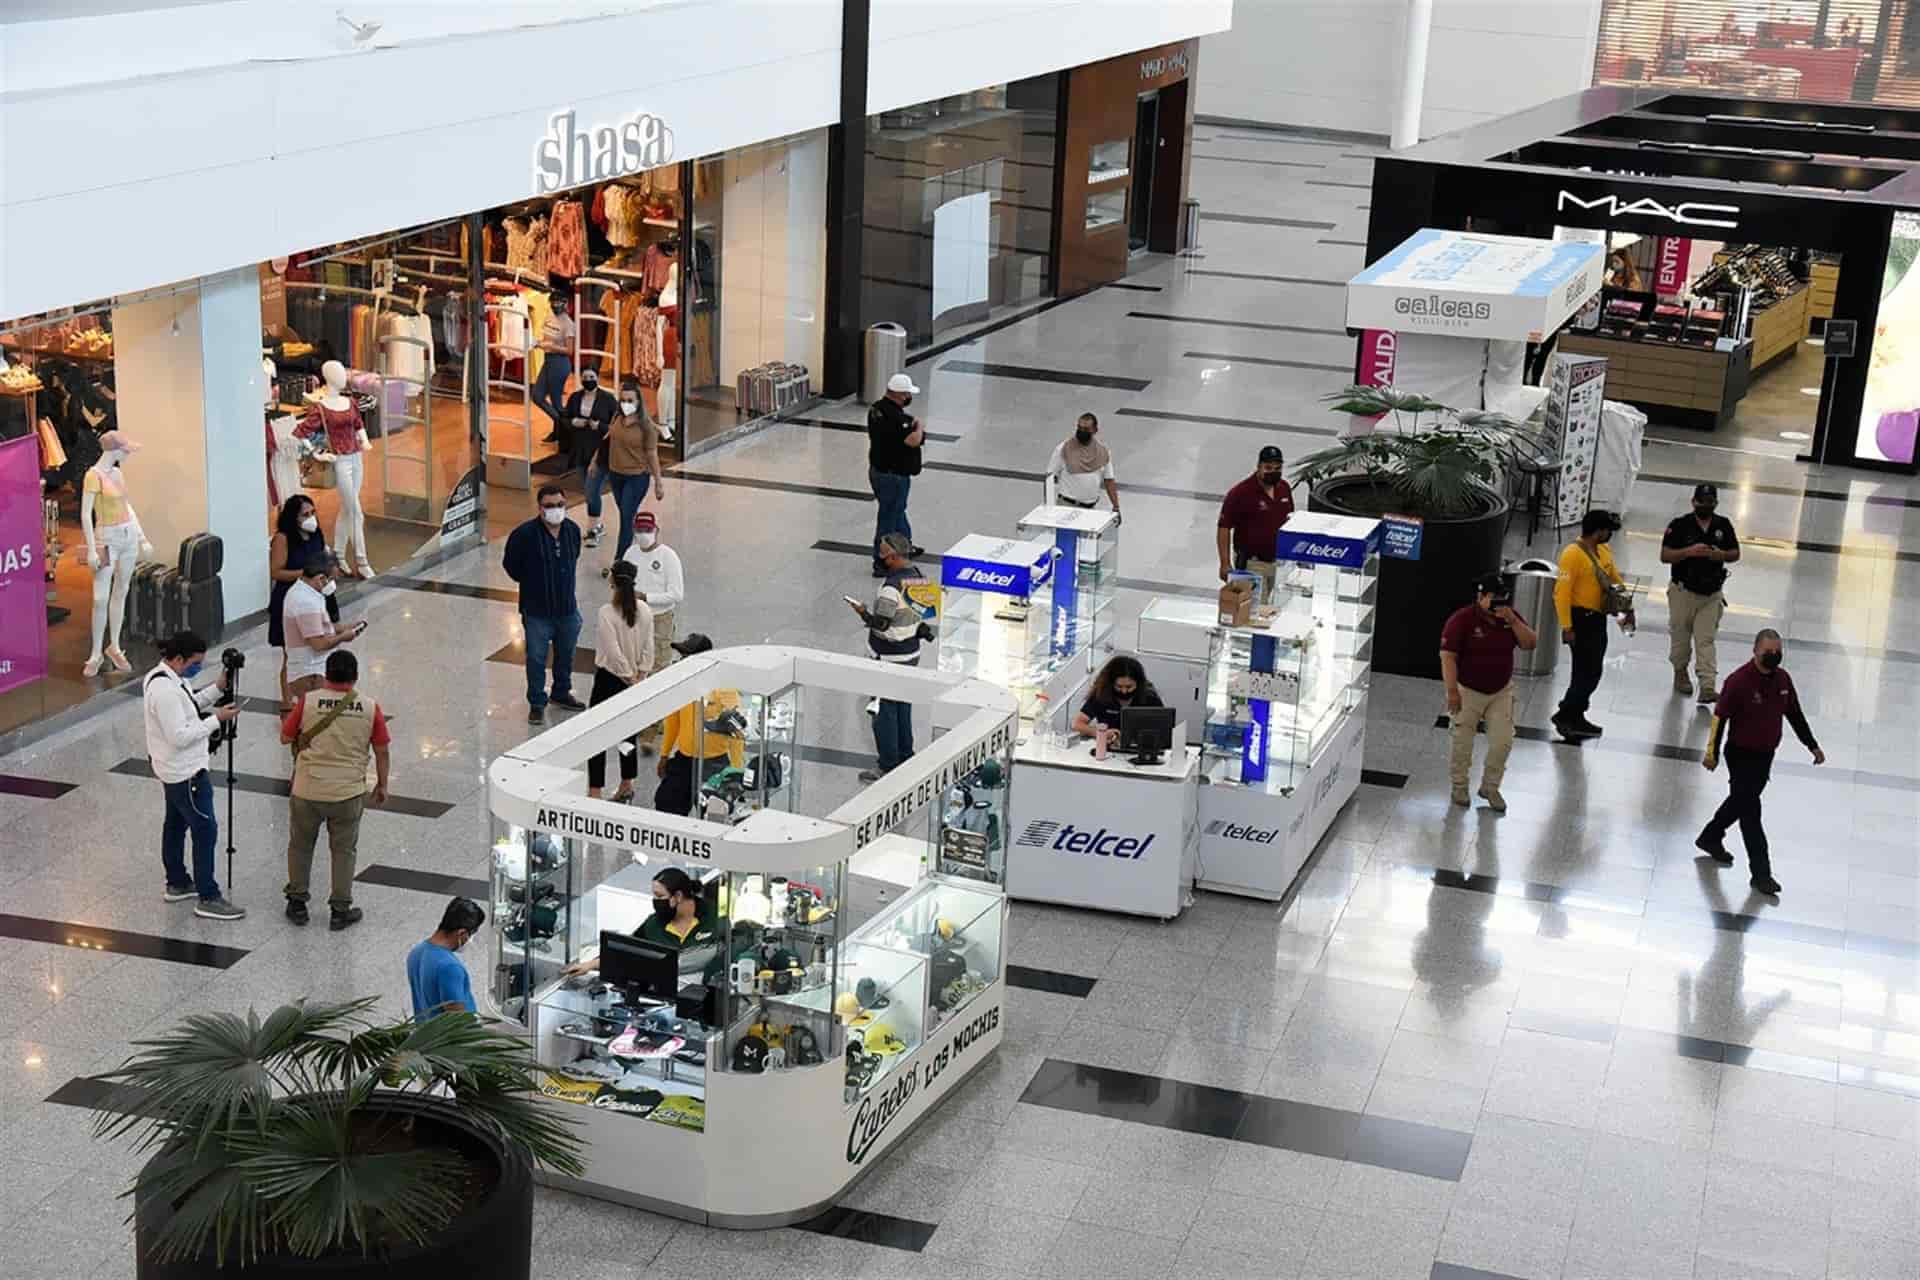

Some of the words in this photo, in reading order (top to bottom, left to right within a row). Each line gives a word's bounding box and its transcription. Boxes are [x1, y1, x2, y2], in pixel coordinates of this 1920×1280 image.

[536, 110, 673, 193] shasa
[1395, 295, 1490, 320] calcas
[1306, 542, 1350, 558] telcel
[971, 569, 1016, 587] telcel
[317, 698, 364, 712] PRESA
[876, 791, 914, 836] PARTE
[917, 780, 931, 807] DE
[935, 768, 948, 794] LA
[952, 740, 987, 784] NUEVA
[991, 724, 1010, 754] ERA
[536, 808, 625, 842] ARTÍCULOS
[630, 827, 712, 860] OFICIALES
[1052, 824, 1156, 859] telcel
[1222, 822, 1279, 844] telcel
[923, 1044, 950, 1089] LOS
[952, 1006, 1000, 1059] MOCHIS
